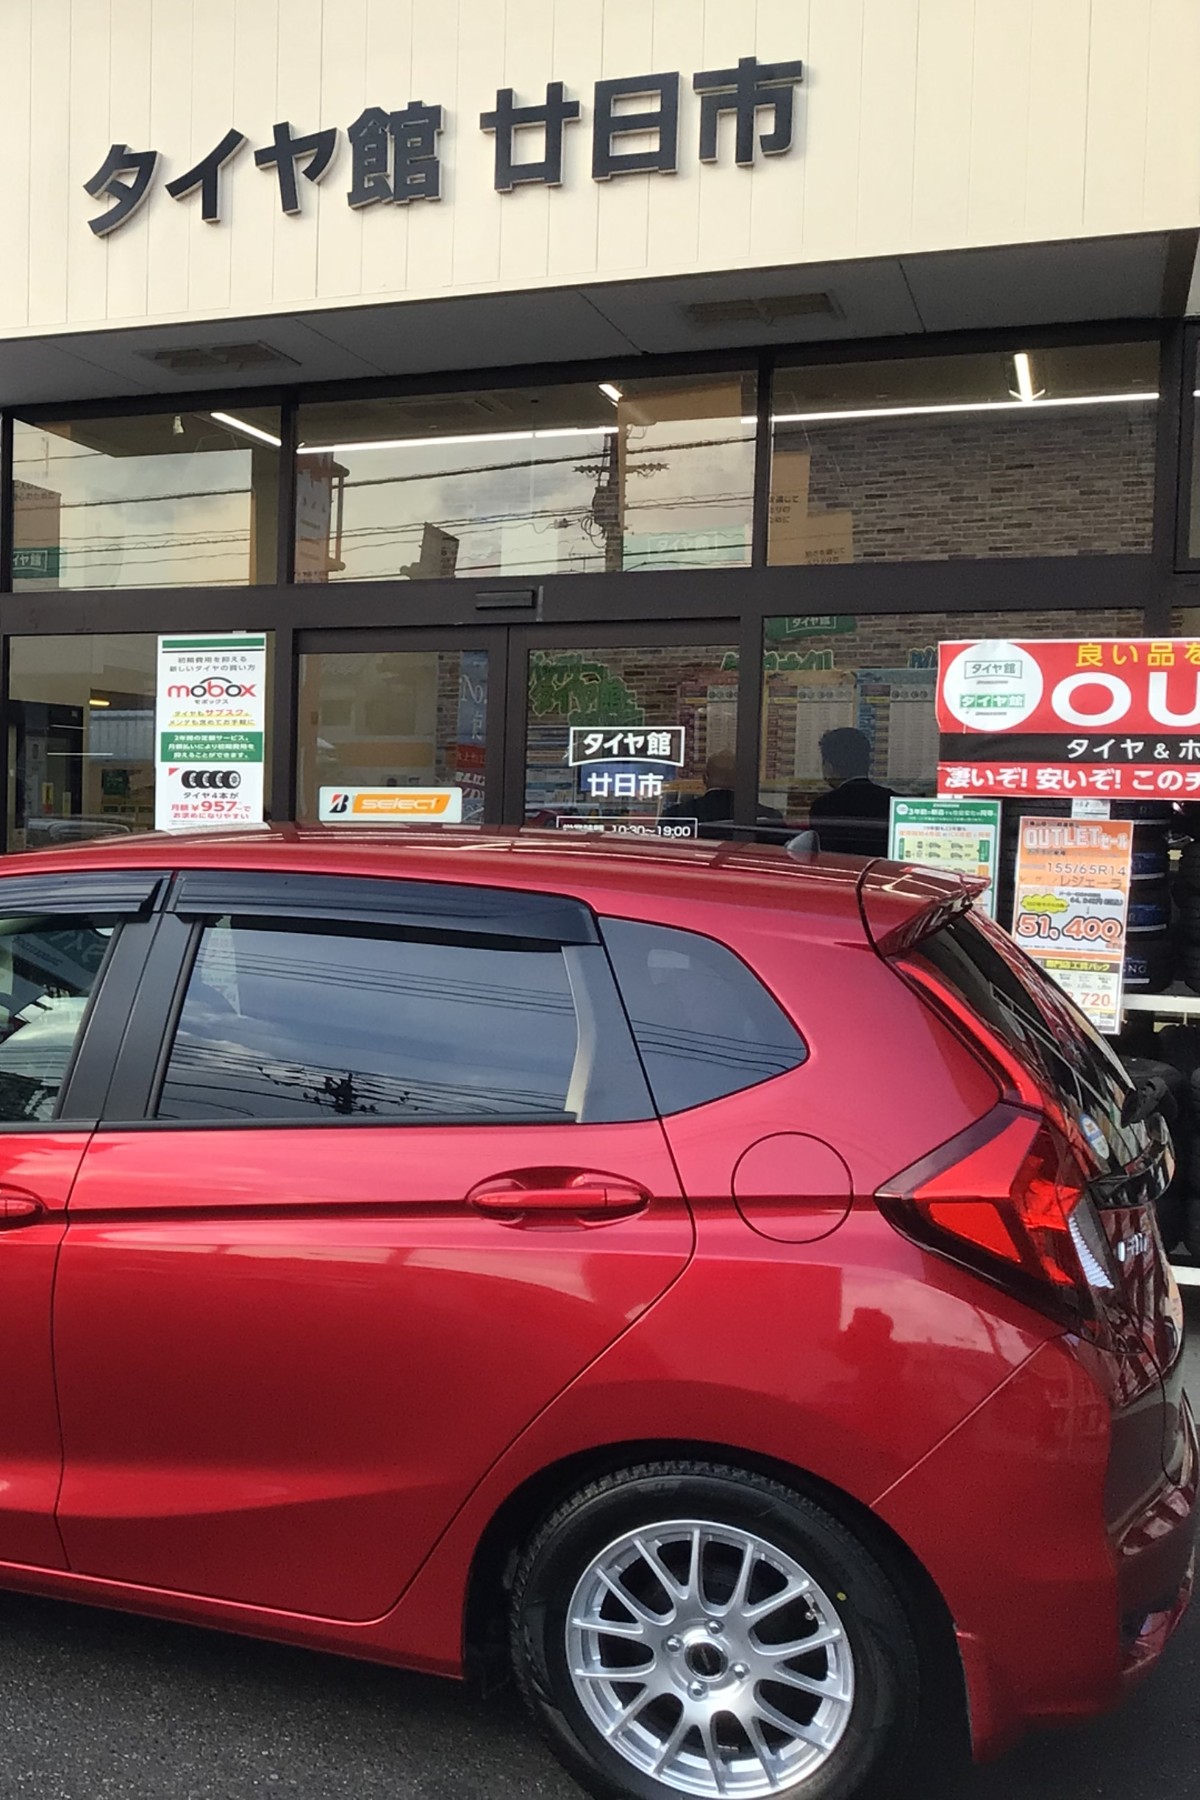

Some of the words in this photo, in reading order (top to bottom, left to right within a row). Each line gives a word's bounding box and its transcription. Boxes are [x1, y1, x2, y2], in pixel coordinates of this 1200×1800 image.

[84, 100, 446, 238] タイヤ館
[480, 55, 804, 193] 廿日市
[167, 679, 257, 698] mobox
[583, 732, 673, 757] タイヤ館
[1067, 739, 1144, 760] タイヤ
[1153, 743, 1170, 759] &
[587, 773, 664, 798] 廿日市
[1047, 861, 1127, 876] 155/65R14
